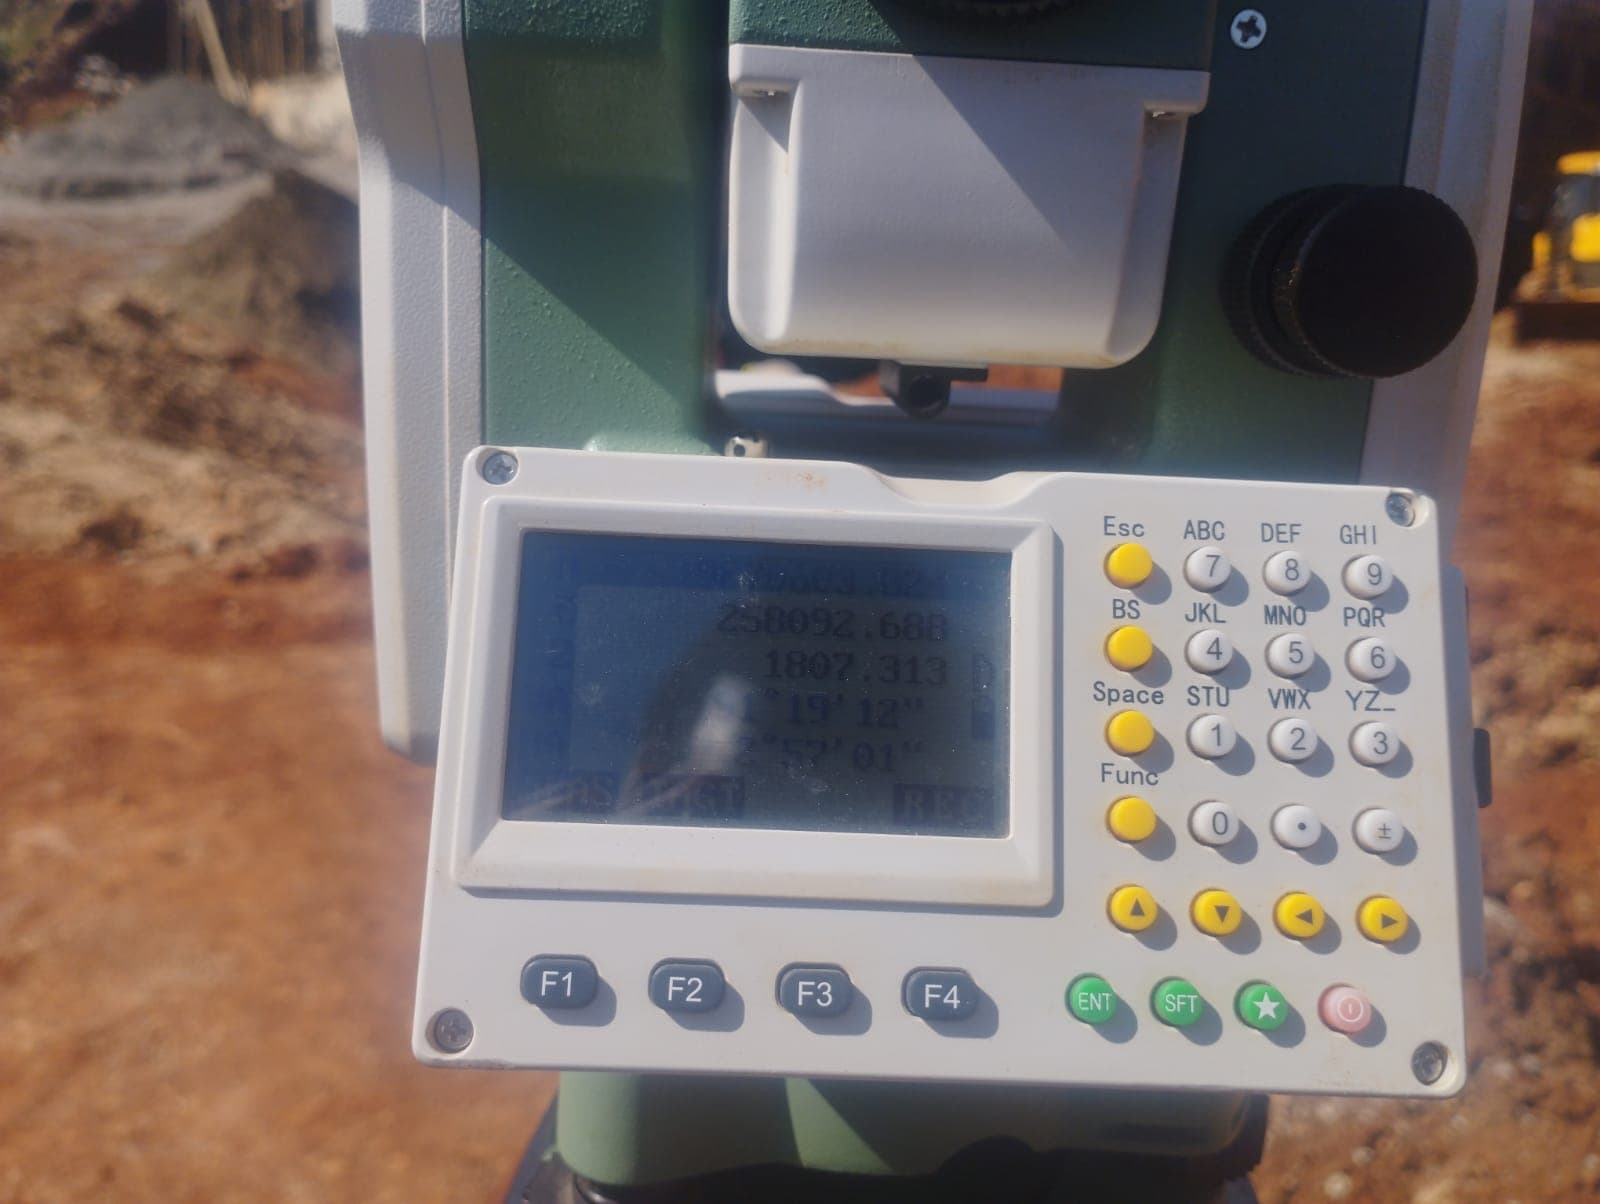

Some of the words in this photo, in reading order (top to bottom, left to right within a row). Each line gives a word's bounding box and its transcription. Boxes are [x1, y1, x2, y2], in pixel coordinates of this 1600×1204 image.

[1103, 516, 1145, 538] Esc
[1183, 520, 1225, 540] ABC
[1261, 523, 1302, 543] DEF
[1340, 525, 1377, 545] GHI
[1206, 555, 1220, 577] 7
[1285, 558, 1300, 581] 8
[1368, 563, 1383, 585] 9
[1112, 599, 1141, 620] BS
[1185, 603, 1226, 623] JKL
[1264, 605, 1307, 626] MNO
[1343, 607, 1386, 628] PQR
[1207, 637, 1223, 660] 4
[1289, 641, 1304, 664] 5
[1371, 646, 1386, 669] 6
[1093, 681, 1164, 706] Space
[1187, 686, 1230, 707] STU
[1268, 689, 1311, 710] VWX
[1211, 725, 1221, 747] 1
[1290, 728, 1306, 750] 2
[1373, 732, 1388, 755] 3
[1102, 763, 1159, 786] Func
[1212, 811, 1228, 835] 0
[541, 970, 574, 997] F1
[668, 976, 703, 1003] F2
[798, 980, 833, 1007] F3
[924, 984, 961, 1009] F4
[1078, 992, 1112, 1011] ENT
[1165, 994, 1198, 1013] SFT
